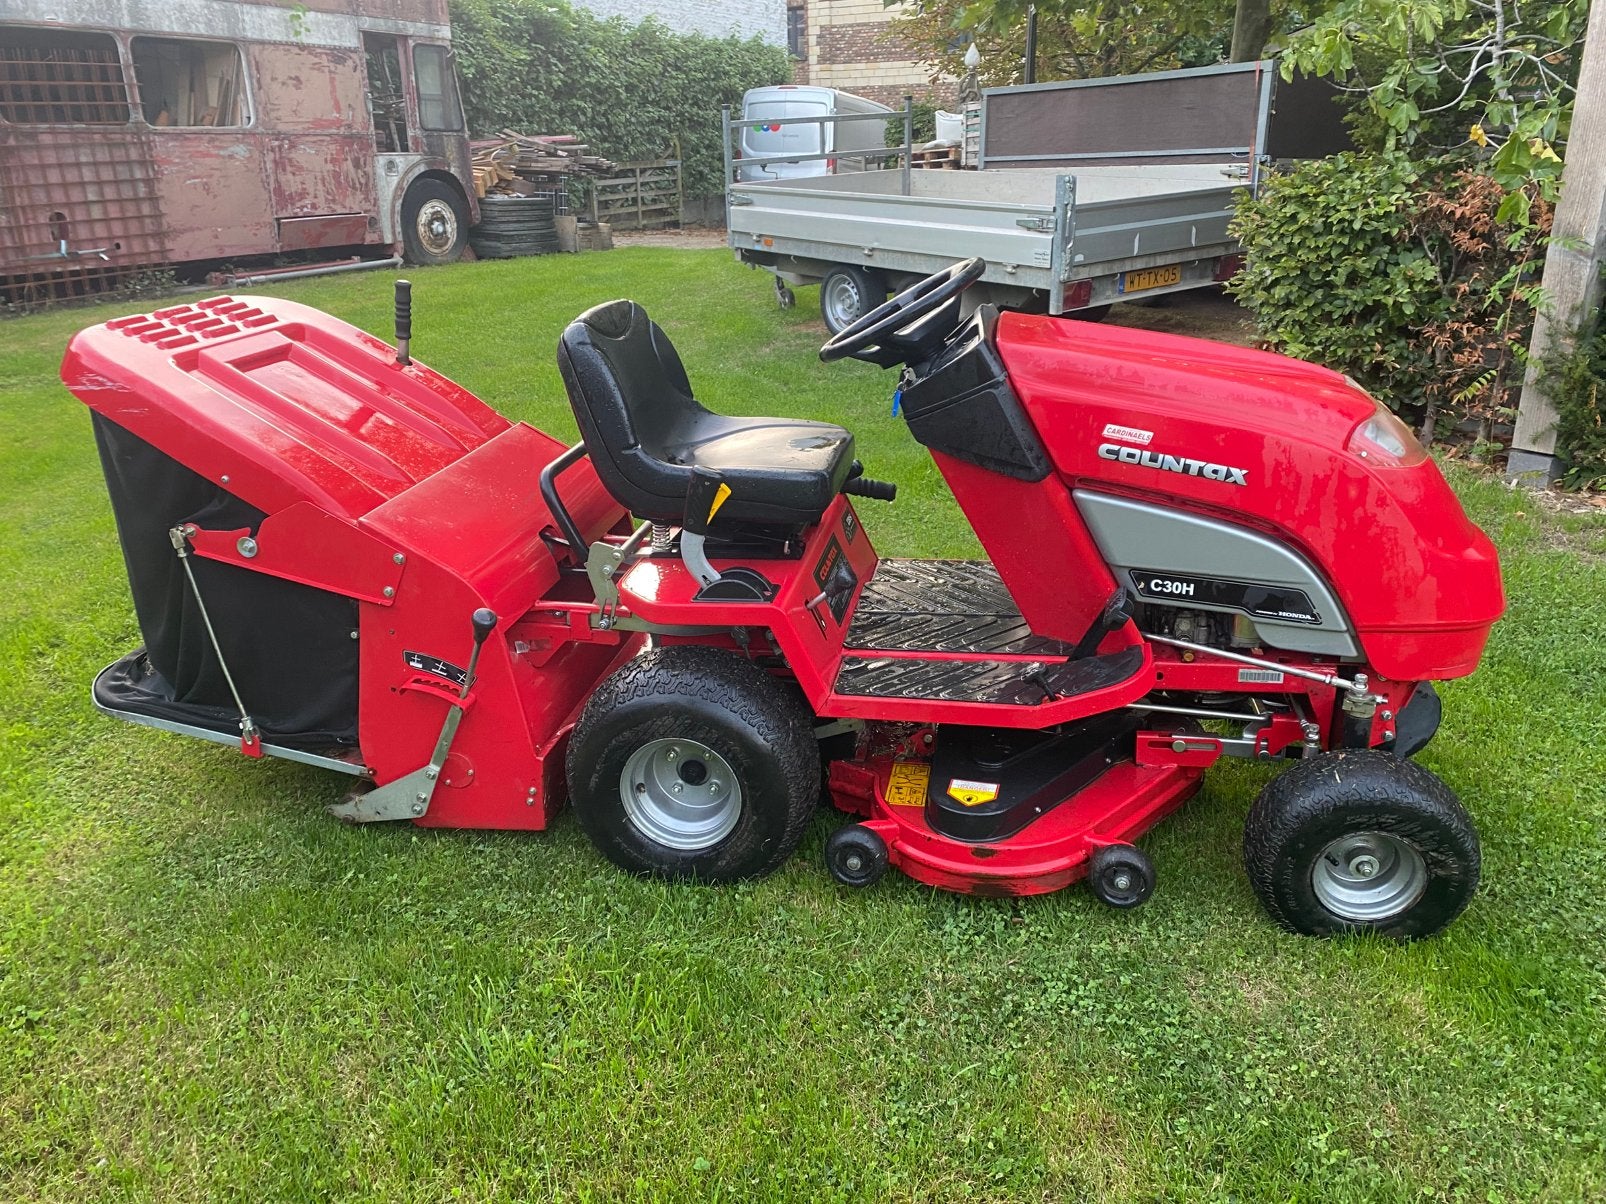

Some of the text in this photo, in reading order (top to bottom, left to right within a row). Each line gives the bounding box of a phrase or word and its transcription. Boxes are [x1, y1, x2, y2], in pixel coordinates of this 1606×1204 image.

[1106, 426, 1151, 442] CARDINAELS
[1097, 443, 1249, 486] COUNTAX
[1150, 579, 1195, 596] C30H
[1278, 611, 1312, 620] HONDA
